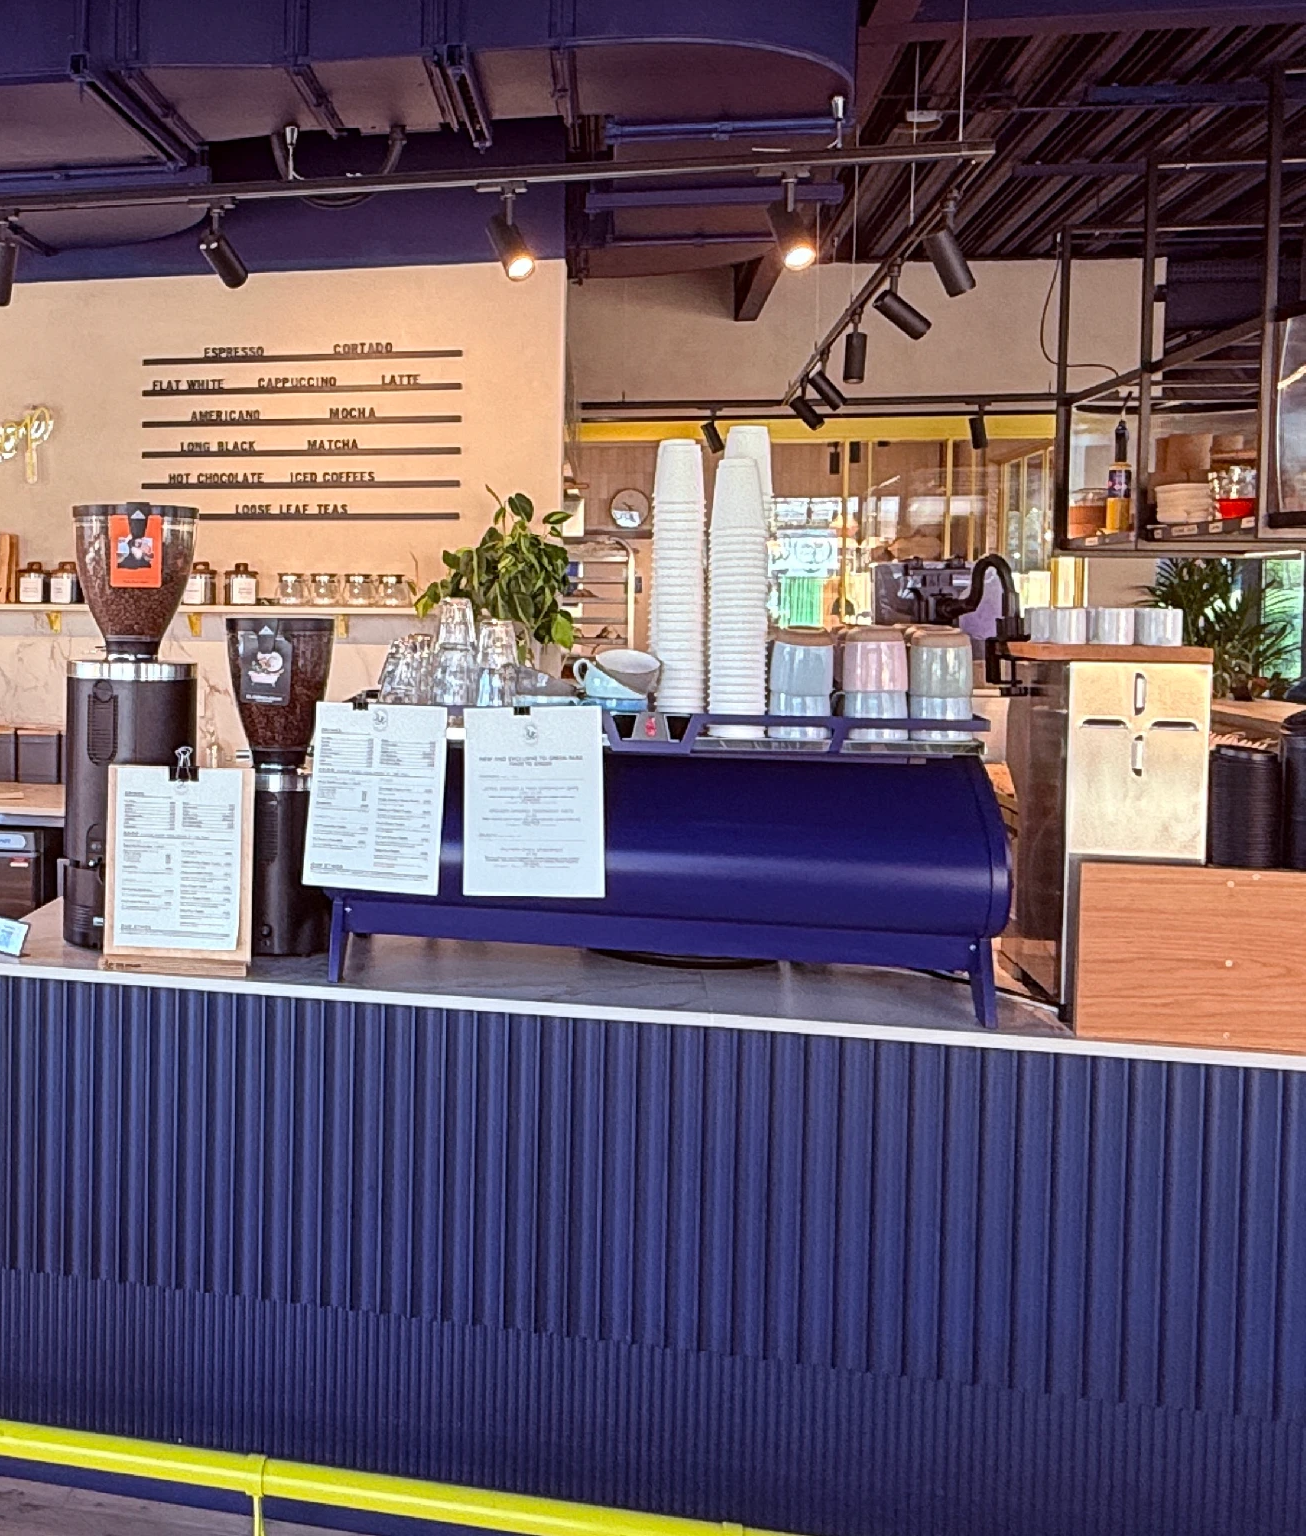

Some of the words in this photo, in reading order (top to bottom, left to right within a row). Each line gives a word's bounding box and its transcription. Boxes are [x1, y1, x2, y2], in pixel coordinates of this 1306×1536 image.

[203, 347, 264, 358] ESPRESSO
[333, 343, 393, 354] CORTADO
[153, 380, 181, 391] FLAT
[187, 379, 225, 390] WHITE
[258, 376, 337, 388] CAPPUCCINO
[381, 374, 421, 385] LATTE
[191, 409, 260, 421] AMERICANO
[329, 407, 376, 419] MOCHA
[180, 441, 210, 452] LONG
[217, 440, 256, 452] BLACK
[307, 439, 359, 450] MATCHA
[168, 473, 191, 484] HOT
[197, 472, 265, 484] CHOCOLATE
[290, 472, 318, 483] ICED
[323, 471, 376, 482] COFFEES
[235, 503, 272, 515] LOOSE
[279, 503, 308, 515] LEAF
[317, 503, 348, 515] TEAS
